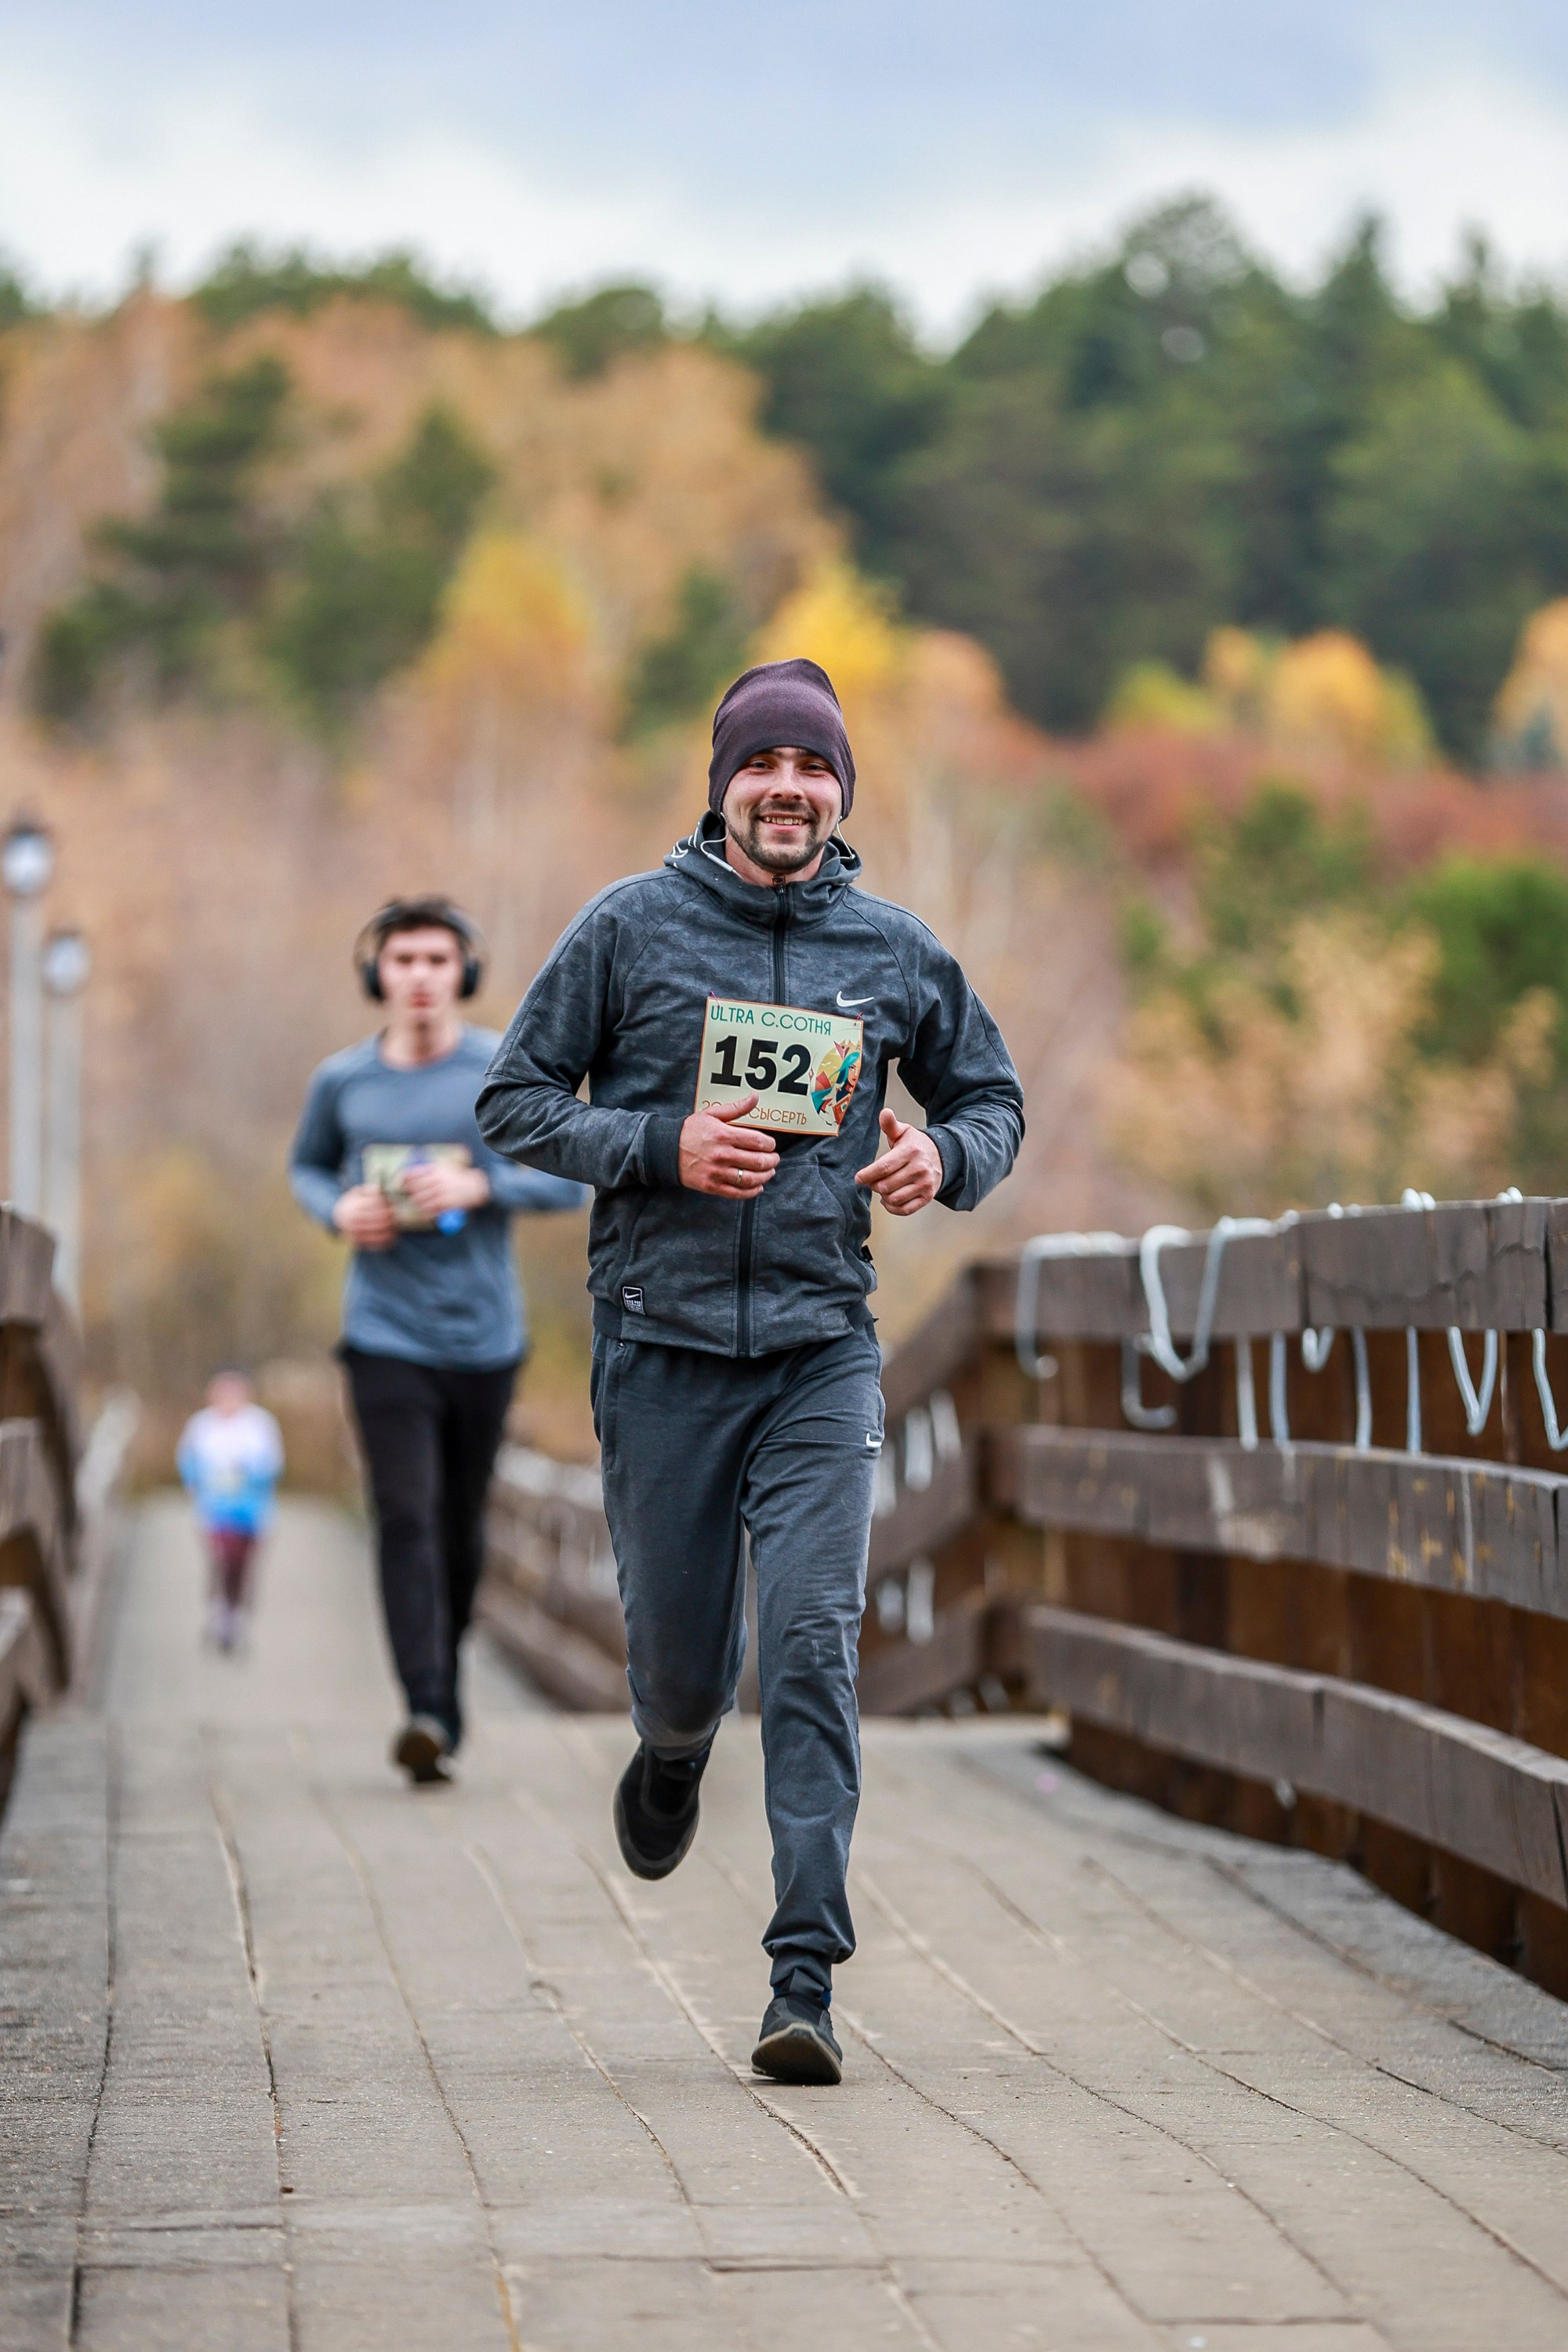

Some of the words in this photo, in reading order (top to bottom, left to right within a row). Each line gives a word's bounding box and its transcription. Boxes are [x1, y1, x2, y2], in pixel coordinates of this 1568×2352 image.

[710, 1005, 754, 1025] ULTRA
[761, 1011, 832, 1036] С.СОТНЯ
[710, 1035, 811, 1096] 152
[748, 1106, 807, 1125] СЫСЕРТЬ
